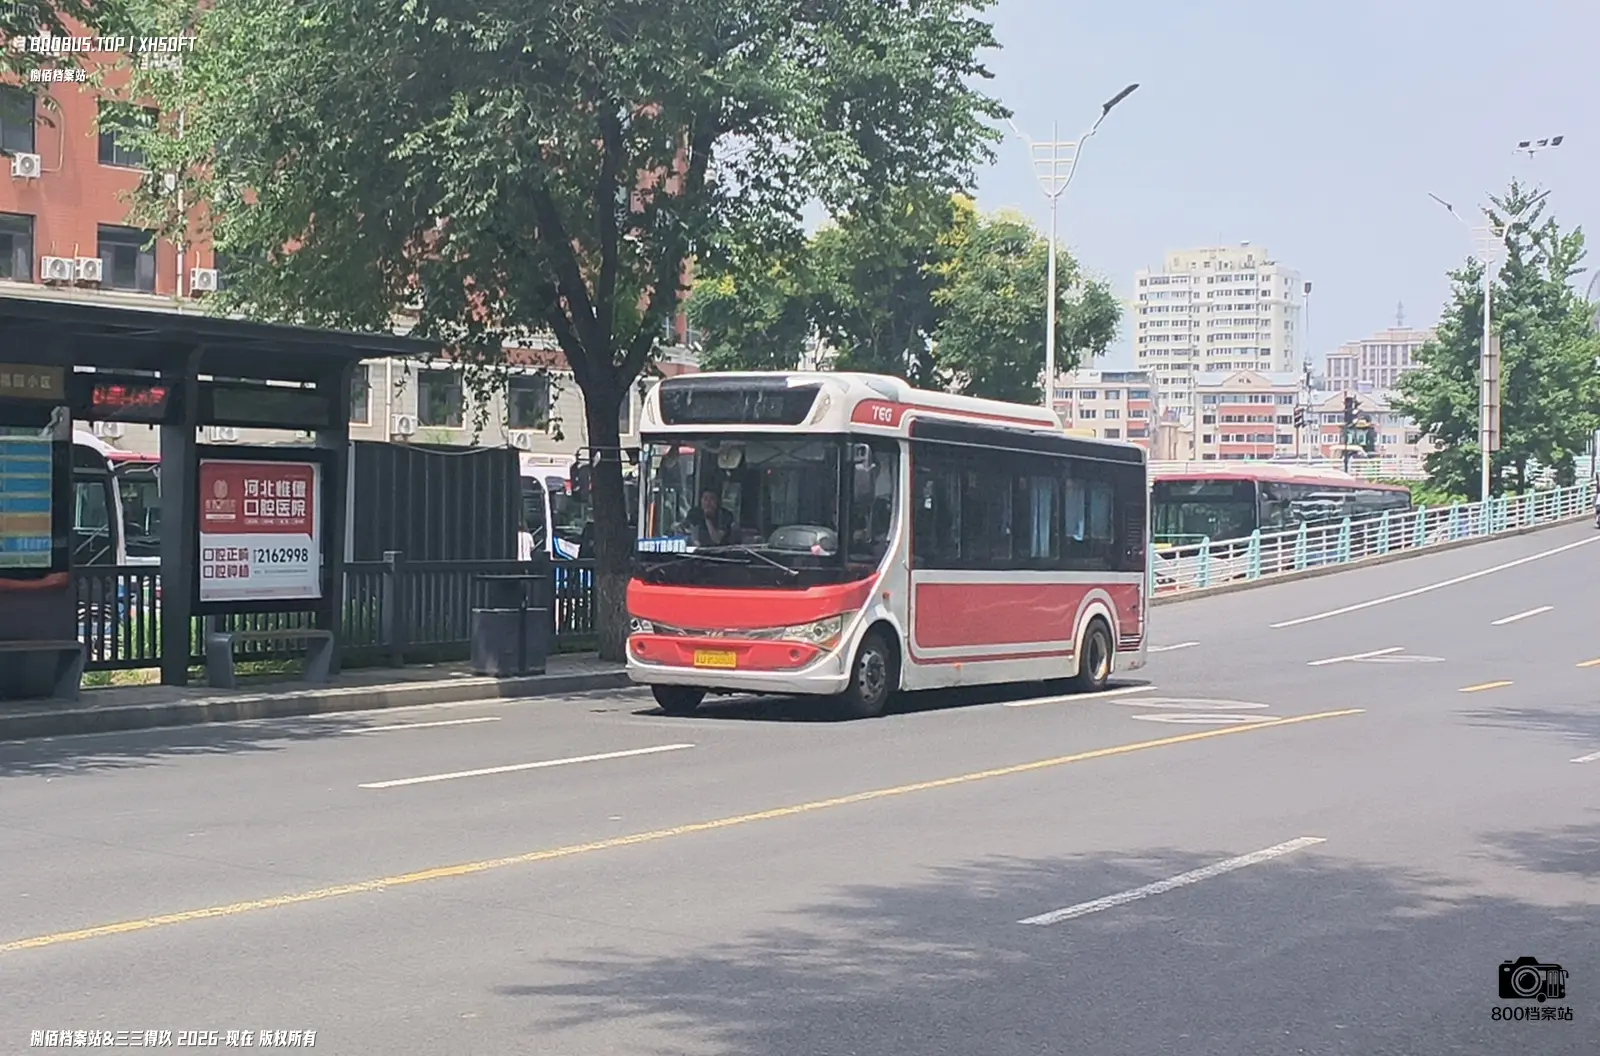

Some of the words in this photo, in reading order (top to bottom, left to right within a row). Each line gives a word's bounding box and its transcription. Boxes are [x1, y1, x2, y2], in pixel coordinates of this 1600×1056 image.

[872, 405, 892, 422] TEG
[244, 499, 306, 517] 口腔医院
[257, 548, 309, 564] 2162998
